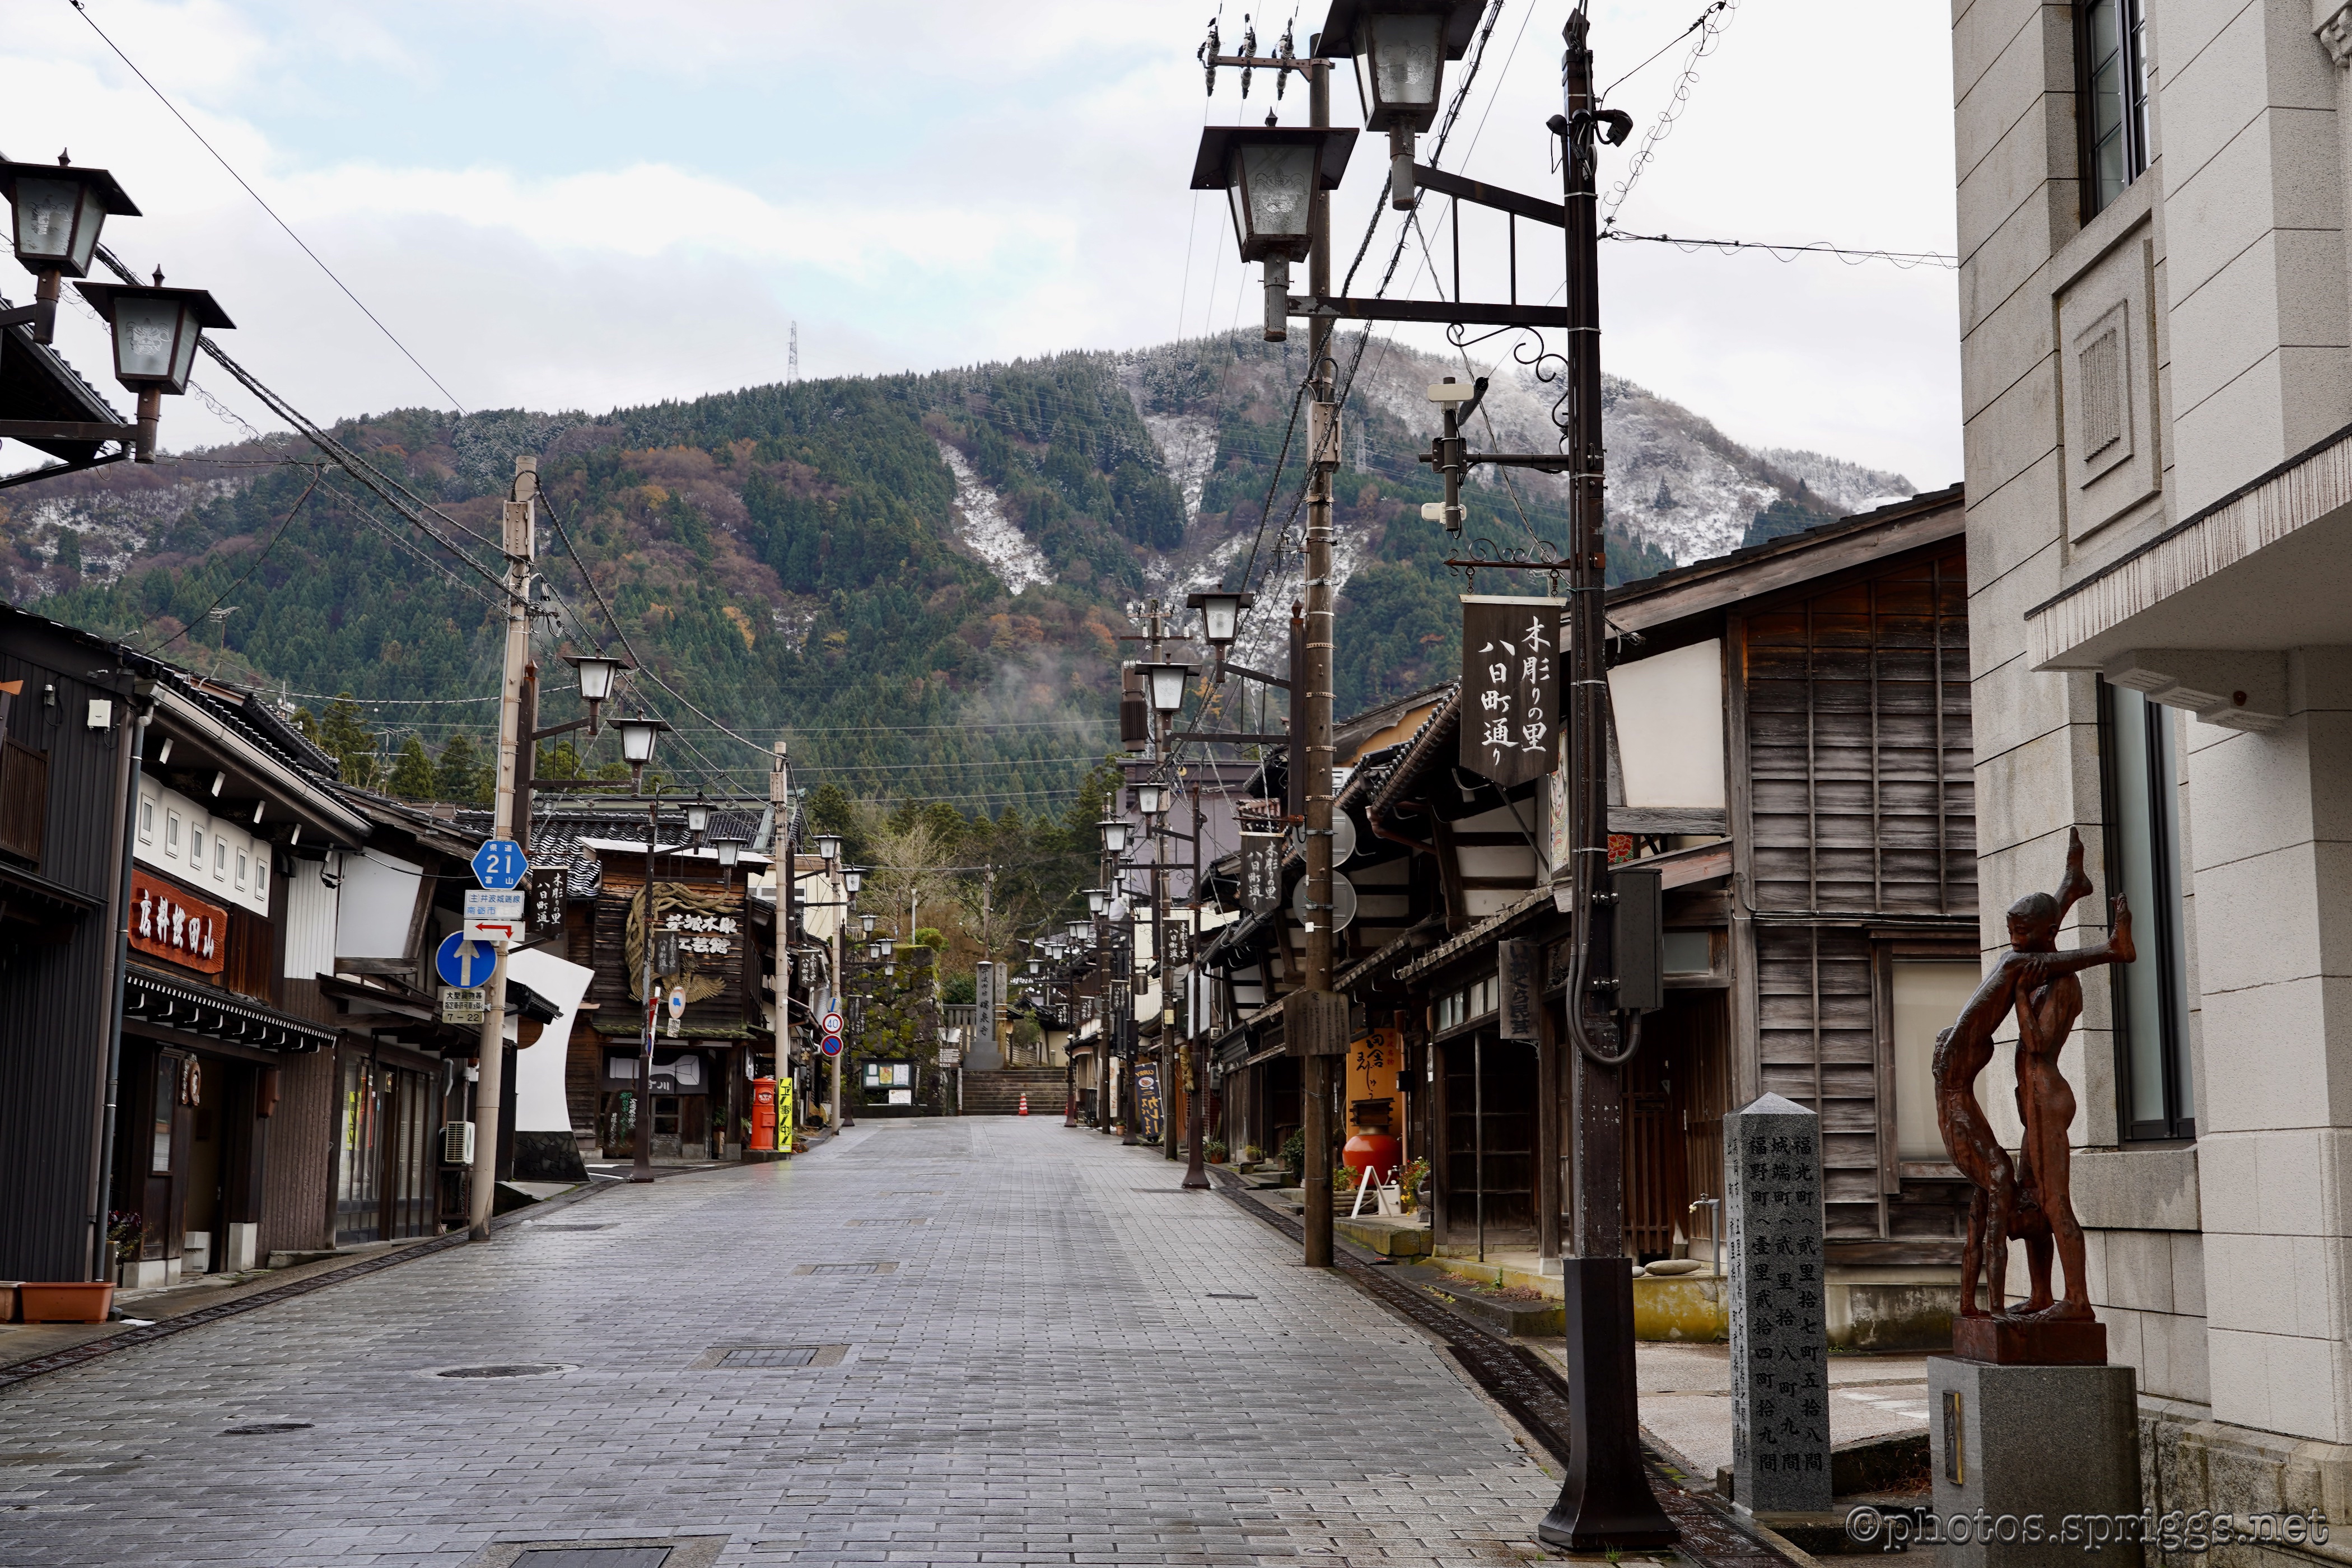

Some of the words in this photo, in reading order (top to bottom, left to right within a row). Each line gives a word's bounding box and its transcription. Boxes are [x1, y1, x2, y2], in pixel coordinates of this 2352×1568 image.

[1478, 639, 1519, 766] 八日町通り
[1520, 615, 1552, 753] 木彫りの里
[486, 854, 511, 874] 21
[489, 843, 512, 852] 県道
[1264, 840, 1278, 899] 木彫りの里
[484, 876, 514, 885] 富山
[552, 872, 563, 925] 木彫りの里
[1247, 851, 1264, 906] 八日町通り
[467, 907, 496, 915] 南砺市
[536, 882, 550, 930] 八日町通り
[446, 991, 483, 1000] 大型貨物等
[827, 1019, 839, 1029] 40
[780, 1086, 791, 1135] 工事中
